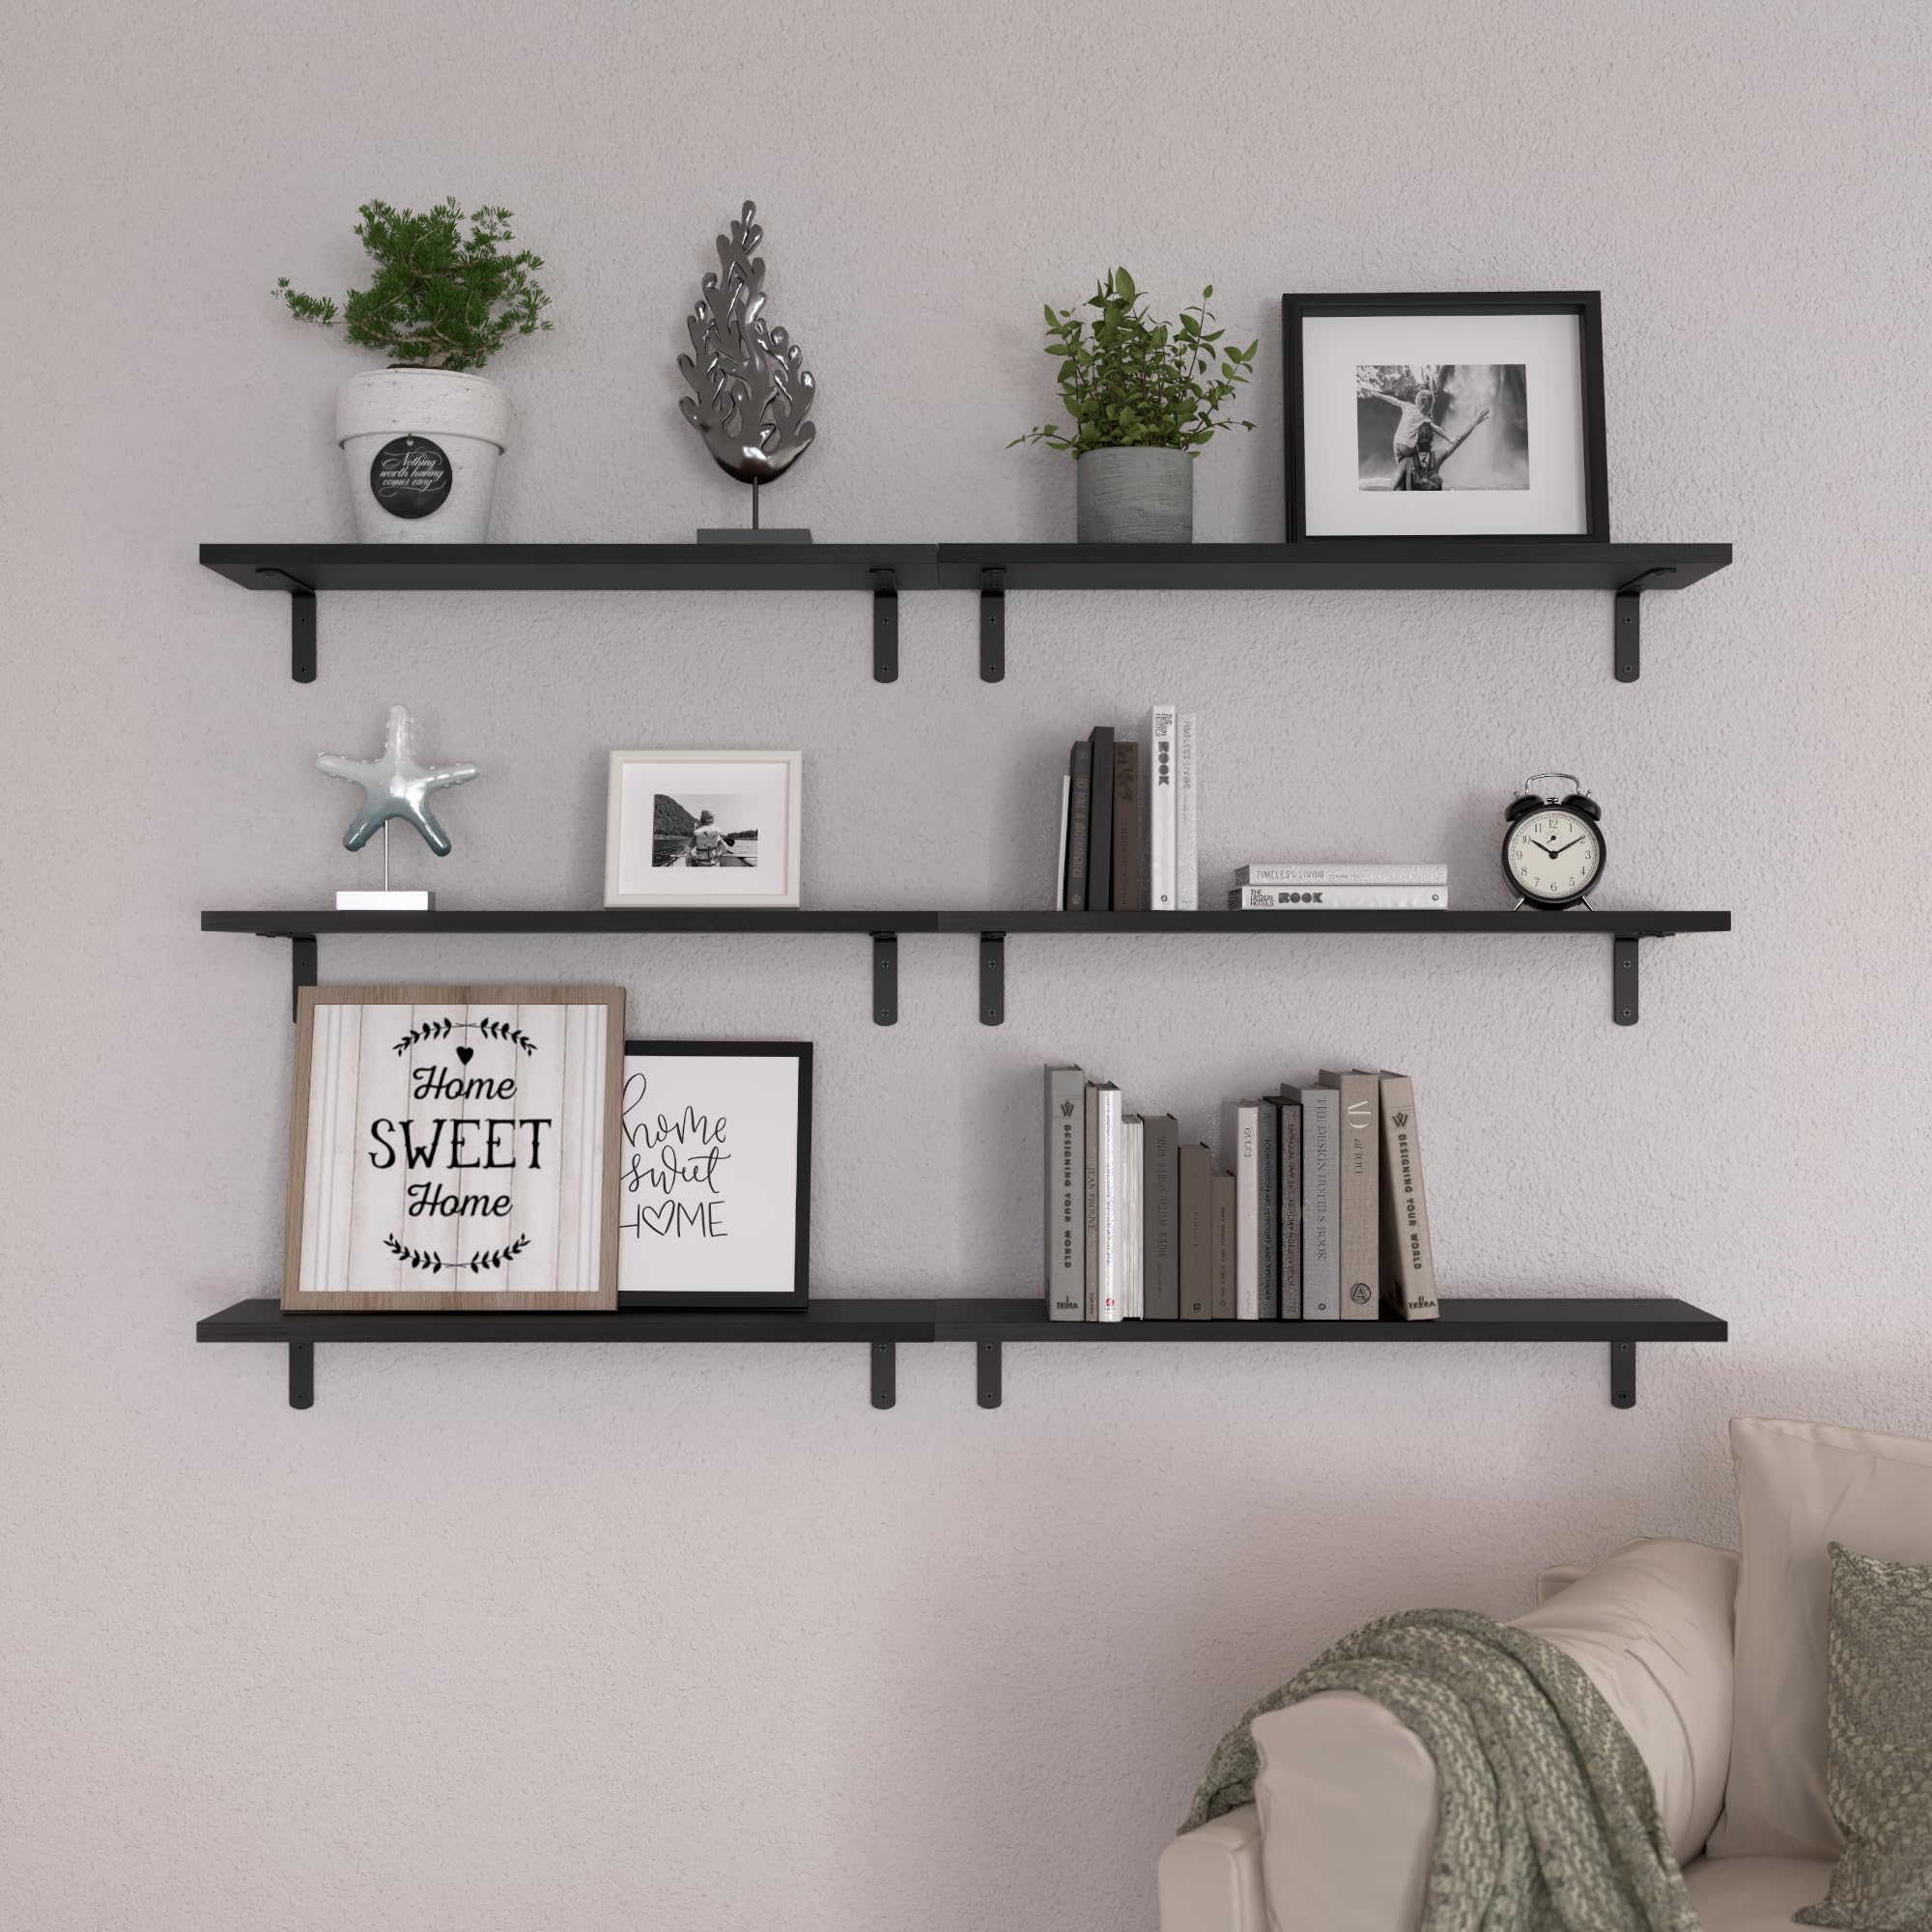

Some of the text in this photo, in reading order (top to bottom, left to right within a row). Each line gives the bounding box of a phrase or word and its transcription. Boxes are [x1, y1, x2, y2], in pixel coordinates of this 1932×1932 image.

[380, 466, 444, 481] worth having
[382, 478, 433, 493] comes easy
[1158, 741, 1170, 786] BOOK
[1534, 822, 1542, 833] 11
[1548, 818, 1558, 829] 12
[1521, 835, 1531, 844] 10
[1516, 850, 1523, 860] 9
[1584, 850, 1591, 859] 3
[1520, 867, 1527, 876] 8
[1580, 867, 1585, 875] 4
[1533, 877, 1540, 888] 7
[1550, 882, 1557, 892] 6
[1569, 877, 1576, 887] 5
[1278, 892, 1323, 903] BOOK
[412, 1065, 518, 1101] Home
[622, 1072, 726, 1149] home
[368, 1118, 552, 1170] SWEET
[620, 1145, 731, 1194] sweet
[1316, 1097, 1327, 1261] THE DESIGN HOTELS BOOK
[407, 1181, 513, 1218] Home
[1064, 1124, 1072, 1268] DESIGNING YOUR WORLD
[1399, 1134, 1422, 1270] DESIGNING YOUR WORLD
[1408, 1300, 1436, 1310] TERRA
